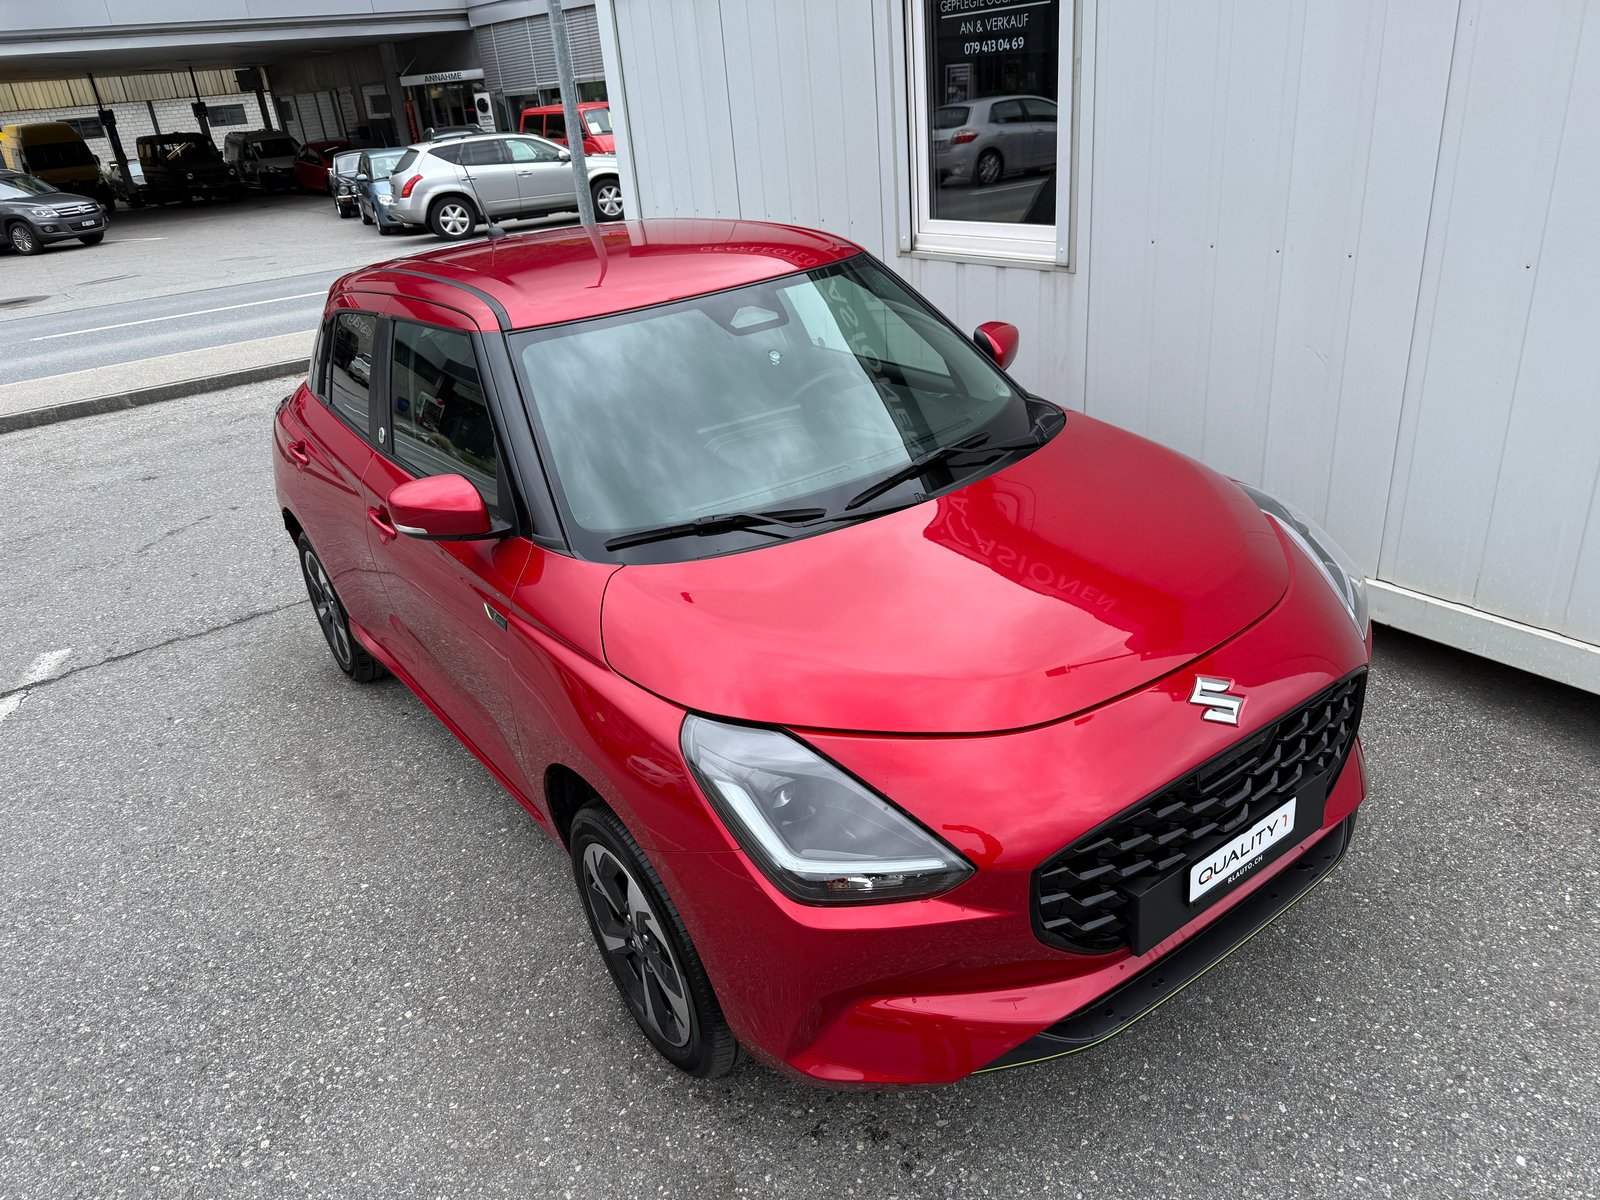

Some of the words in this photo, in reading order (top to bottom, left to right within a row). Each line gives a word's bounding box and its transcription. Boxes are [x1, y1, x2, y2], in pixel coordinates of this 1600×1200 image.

[960, 21, 973, 35] AN
[976, 20, 983, 33] &
[985, 13, 1029, 31] VERKAUF
[964, 42, 980, 55] 079
[982, 40, 996, 53] 413
[998, 38, 1010, 51] 04
[1012, 36, 1024, 49] 69
[425, 72, 462, 82] ANNAHME
[1198, 818, 1278, 886] QUALITY
[1227, 855, 1263, 884] RLAUTO.CH
